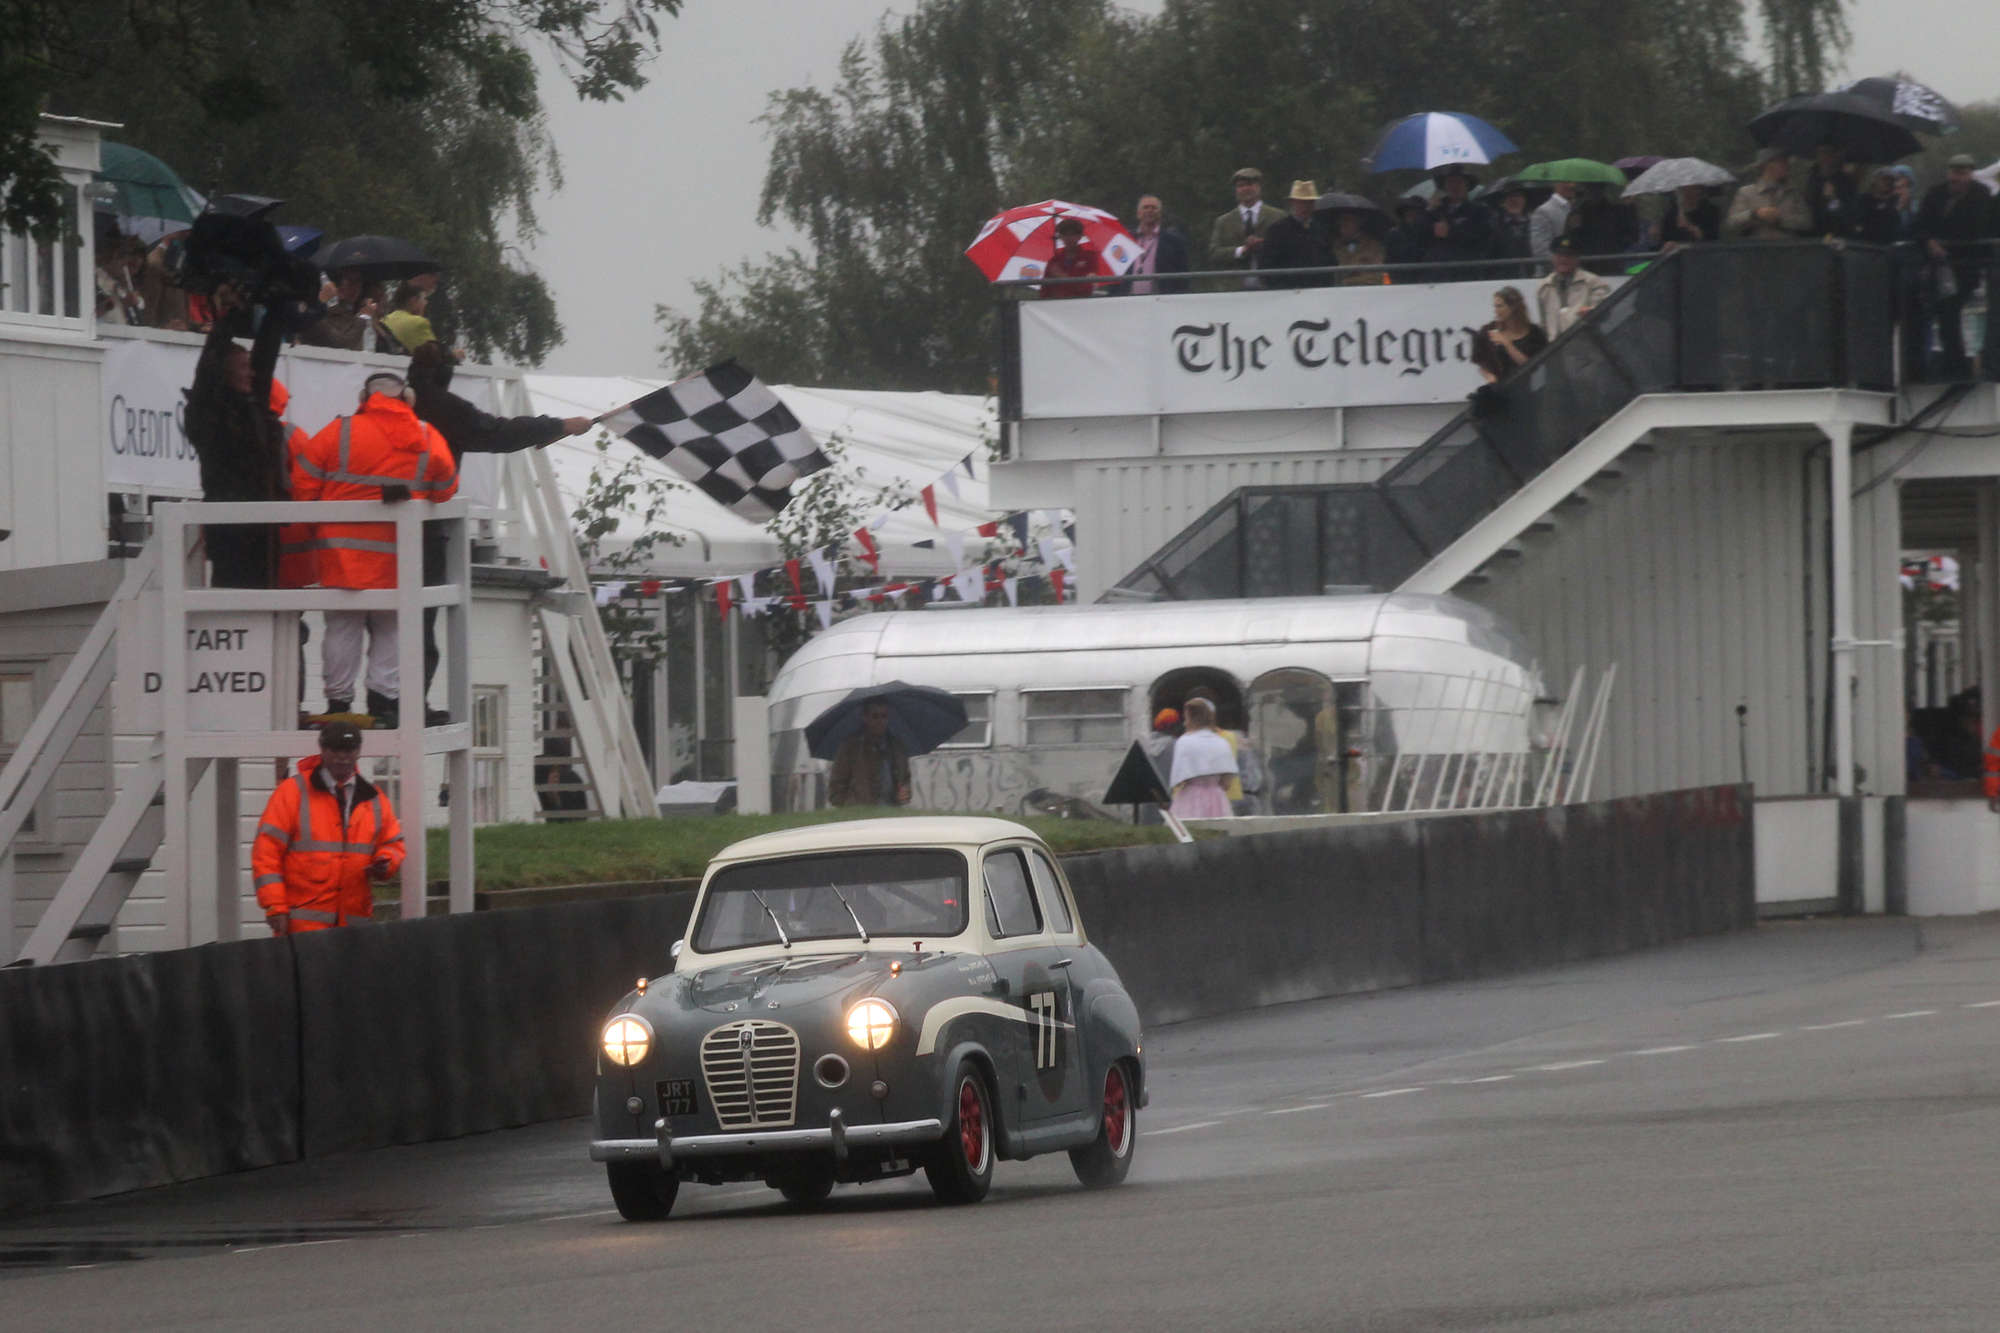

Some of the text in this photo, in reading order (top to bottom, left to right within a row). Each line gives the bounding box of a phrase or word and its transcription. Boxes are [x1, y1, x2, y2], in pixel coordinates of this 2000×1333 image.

[1171, 317, 1481, 382] The Telegra
[110, 394, 173, 459] CREDIT
[186, 629, 249, 651] TART
[144, 671, 266, 694] DAYED
[1030, 991, 1056, 1069] 77
[662, 1081, 691, 1097] JRT
